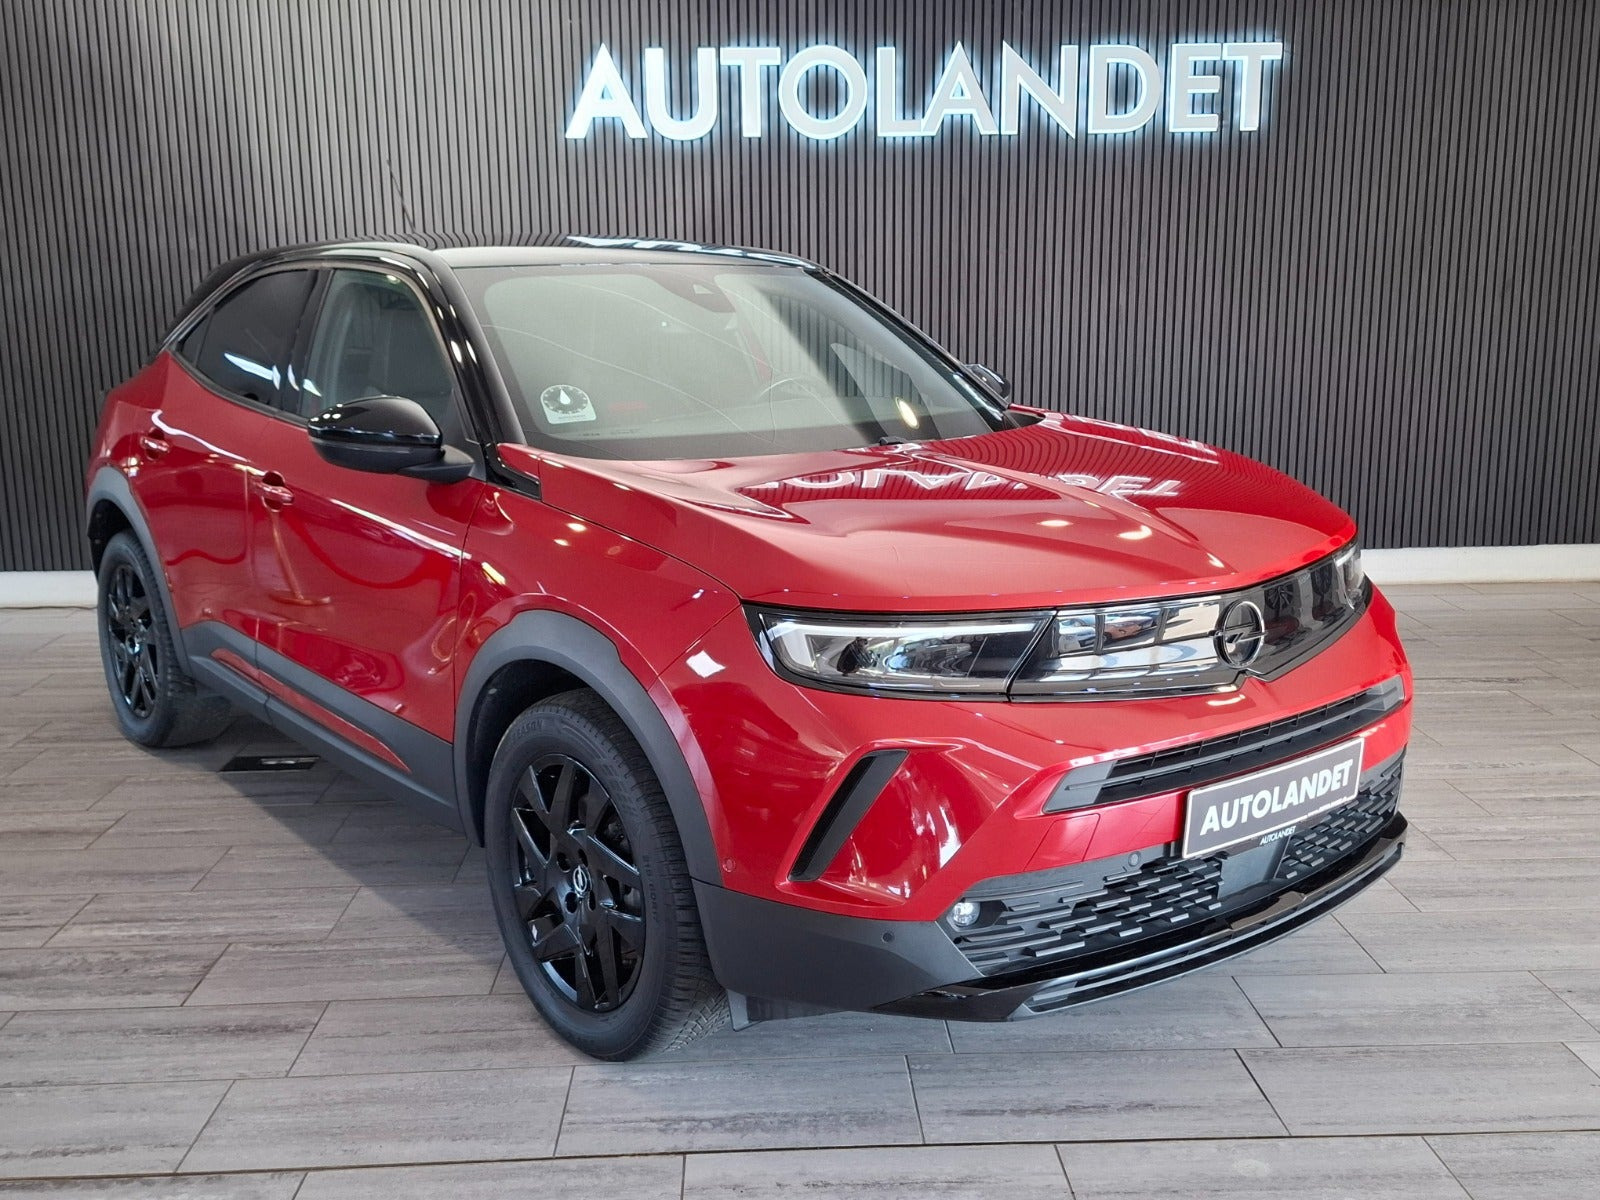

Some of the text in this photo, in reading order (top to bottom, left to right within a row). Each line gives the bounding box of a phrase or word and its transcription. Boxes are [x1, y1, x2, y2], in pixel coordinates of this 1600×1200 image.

[565, 41, 1282, 140] AUTOLANDET
[1200, 759, 1353, 836] AUTOLANDET
[1260, 825, 1297, 845] AUTOLANDET
